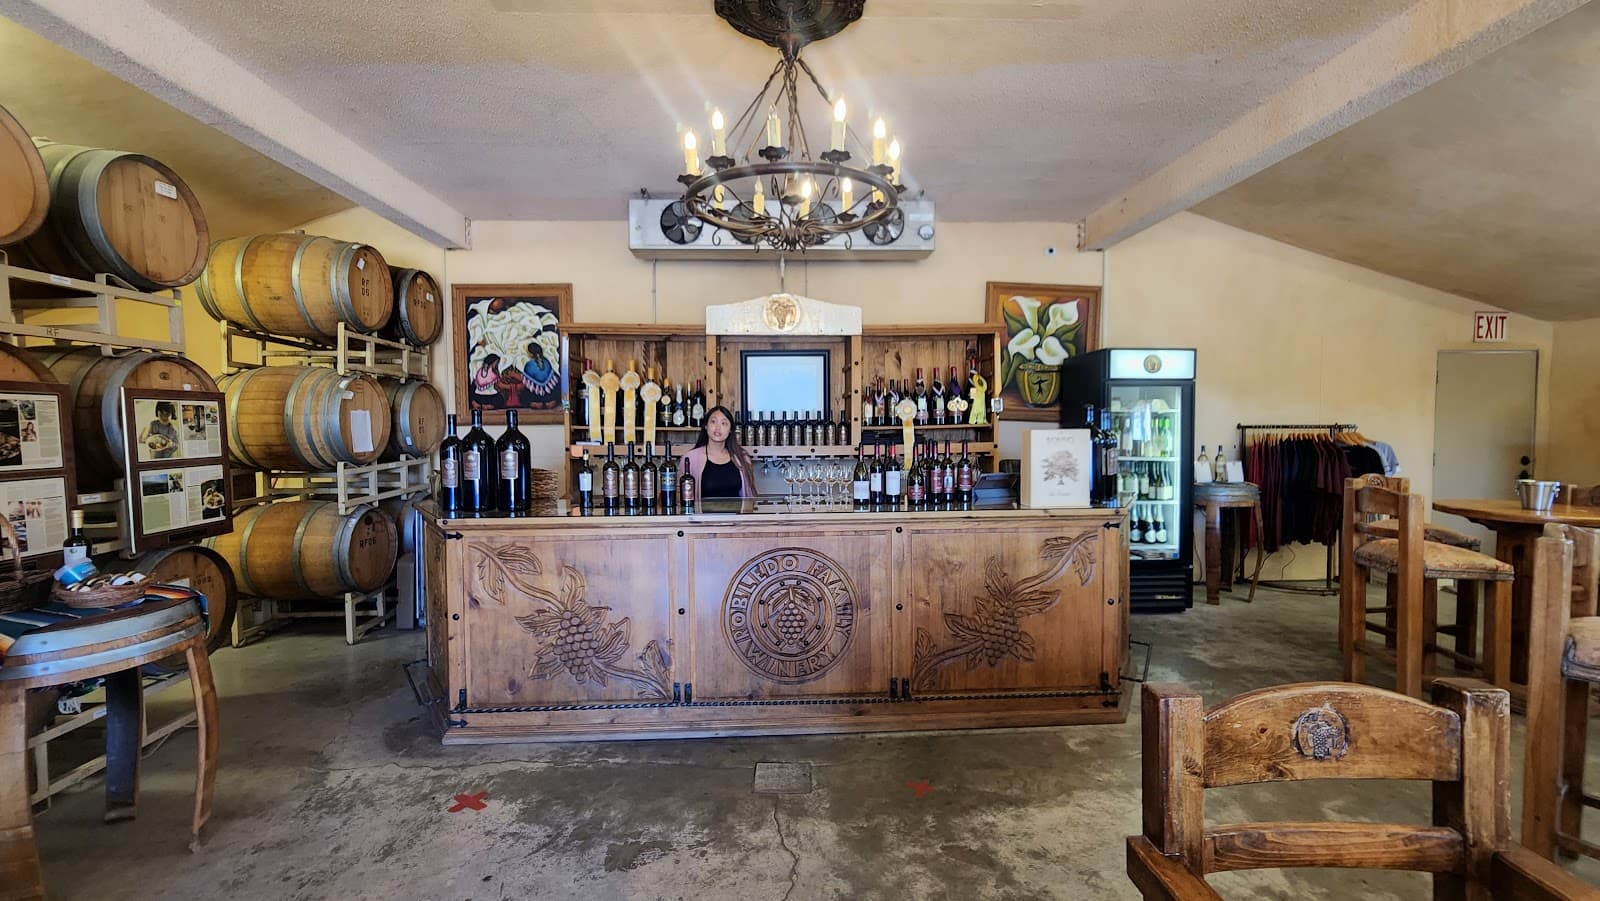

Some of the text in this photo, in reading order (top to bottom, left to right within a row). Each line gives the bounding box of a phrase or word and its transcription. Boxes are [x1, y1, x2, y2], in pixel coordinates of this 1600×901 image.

[1476, 315, 1507, 339] EXIT
[729, 553, 854, 645] ROBLEDO FAMILY
[746, 639, 836, 677] WINERY
